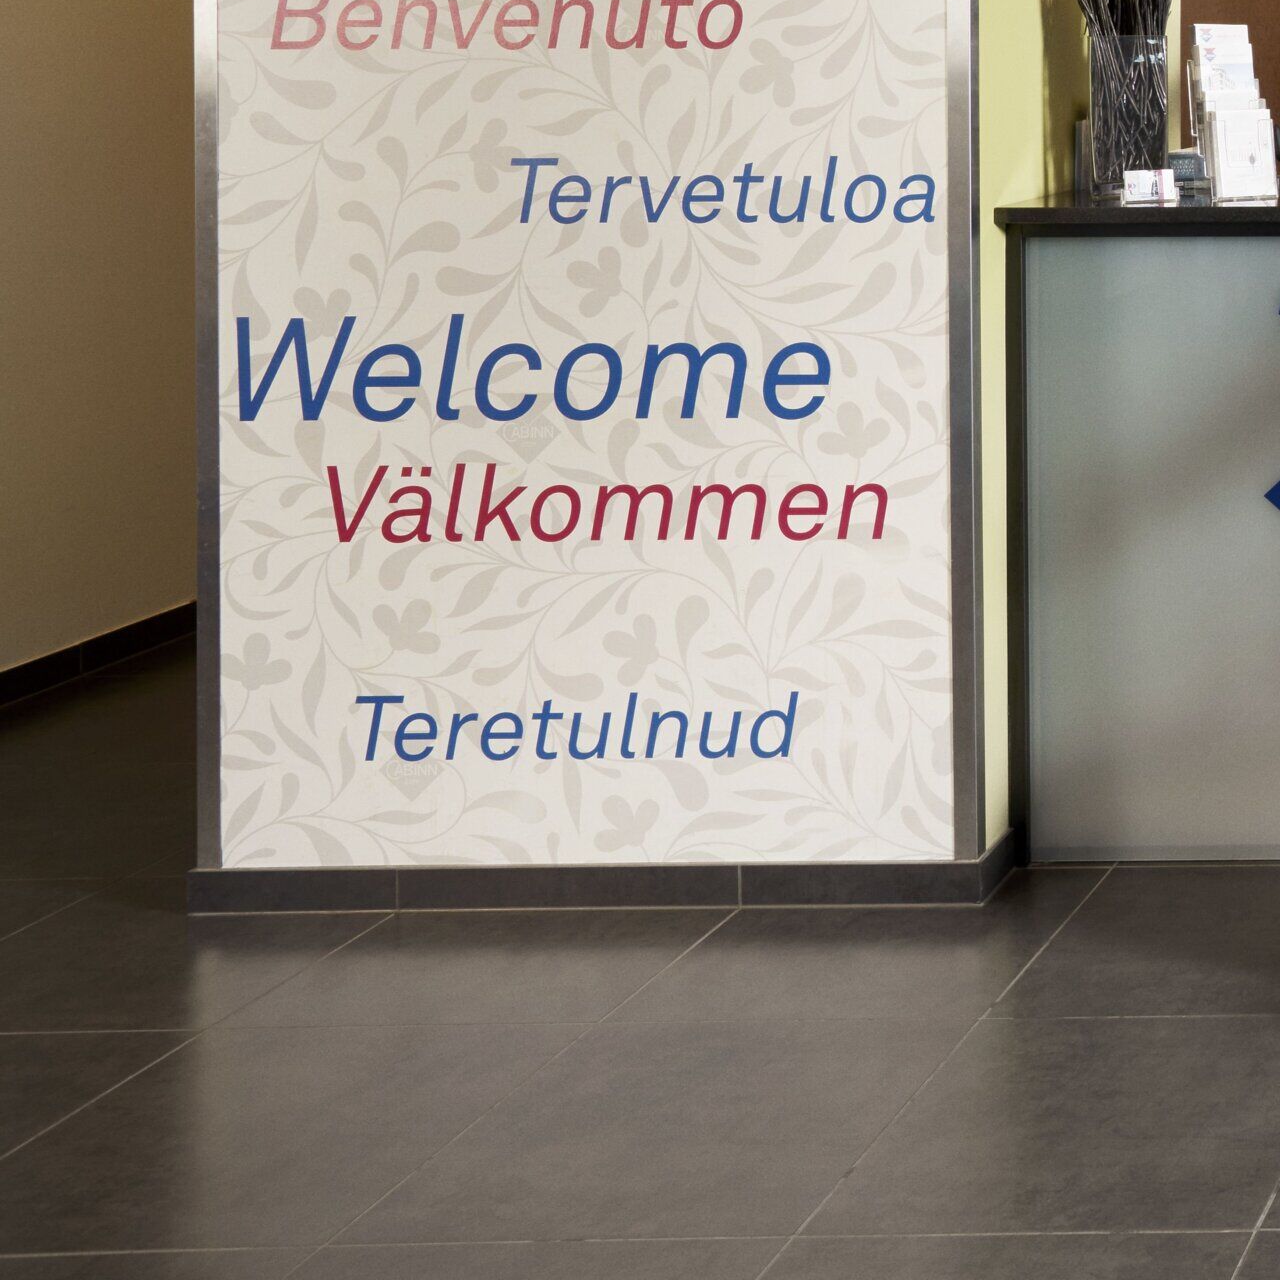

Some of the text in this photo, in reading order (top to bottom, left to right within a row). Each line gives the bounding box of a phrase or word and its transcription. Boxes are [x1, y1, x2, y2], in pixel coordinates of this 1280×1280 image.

[509, 155, 936, 226] Tervetuloa
[233, 312, 833, 424] Welcome
[325, 461, 890, 545] Välkommen
[353, 690, 799, 764] Teretulnud
